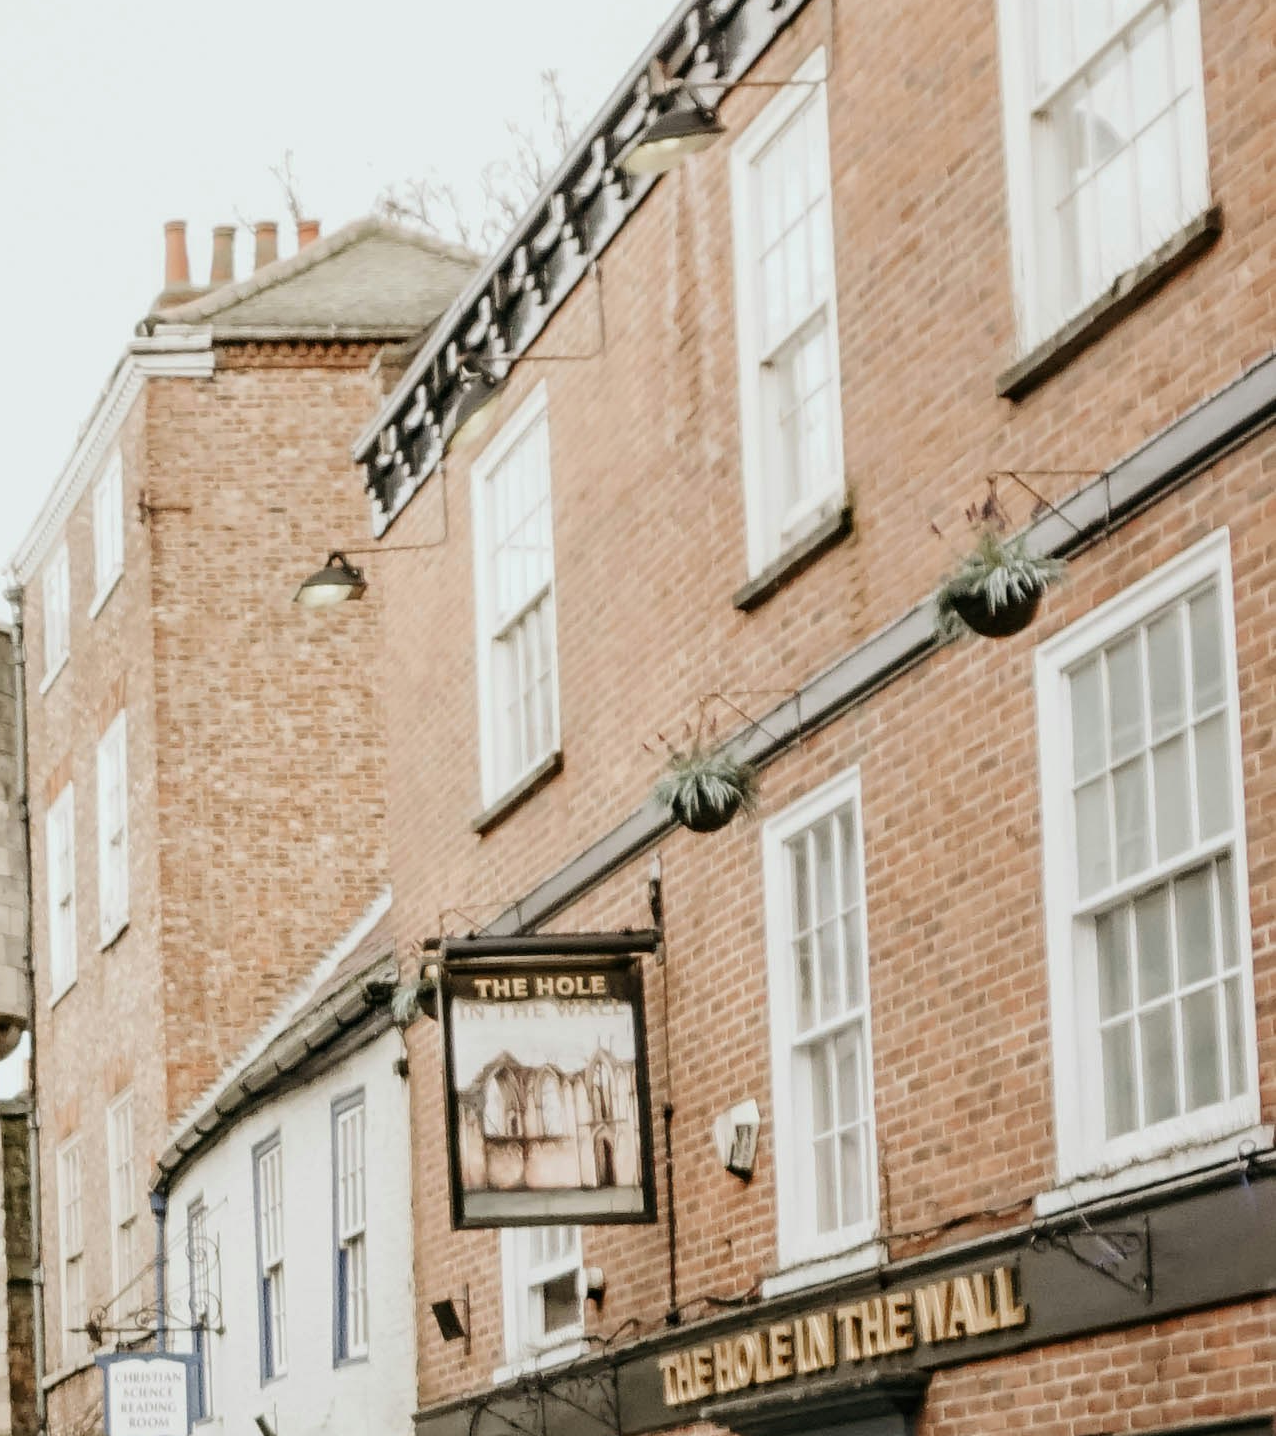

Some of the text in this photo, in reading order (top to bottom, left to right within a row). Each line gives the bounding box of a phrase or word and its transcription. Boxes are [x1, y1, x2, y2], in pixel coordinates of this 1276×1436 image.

[473, 975, 607, 998] THE HOLE
[659, 1267, 1027, 1405] THE HOLE IN THE WALL
[115, 1371, 182, 1383] CHRISTIAN
[123, 1387, 173, 1398] SCIENCE
[121, 1403, 177, 1413] READING
[129, 1418, 170, 1428] ROOM
